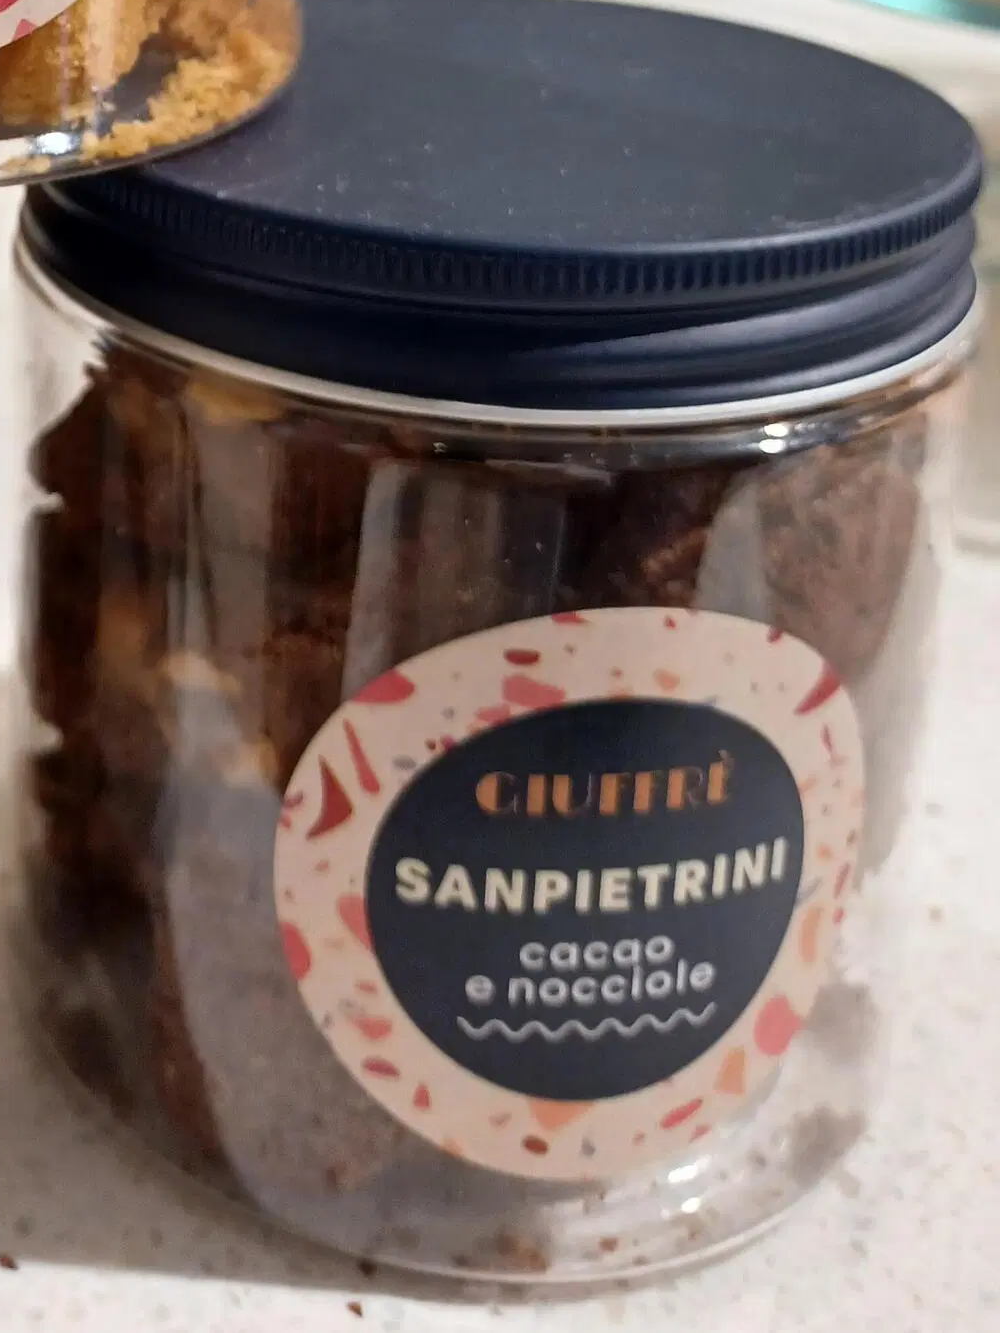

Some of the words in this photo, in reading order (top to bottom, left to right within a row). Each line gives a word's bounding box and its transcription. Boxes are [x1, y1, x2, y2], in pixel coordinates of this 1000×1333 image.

[475, 750, 735, 818] GIUFFRÈ
[395, 836, 789, 914] SANPIETRINI
[519, 934, 675, 973] cacao
[465, 974, 495, 1005] e
[508, 959, 717, 1006] nocciole
